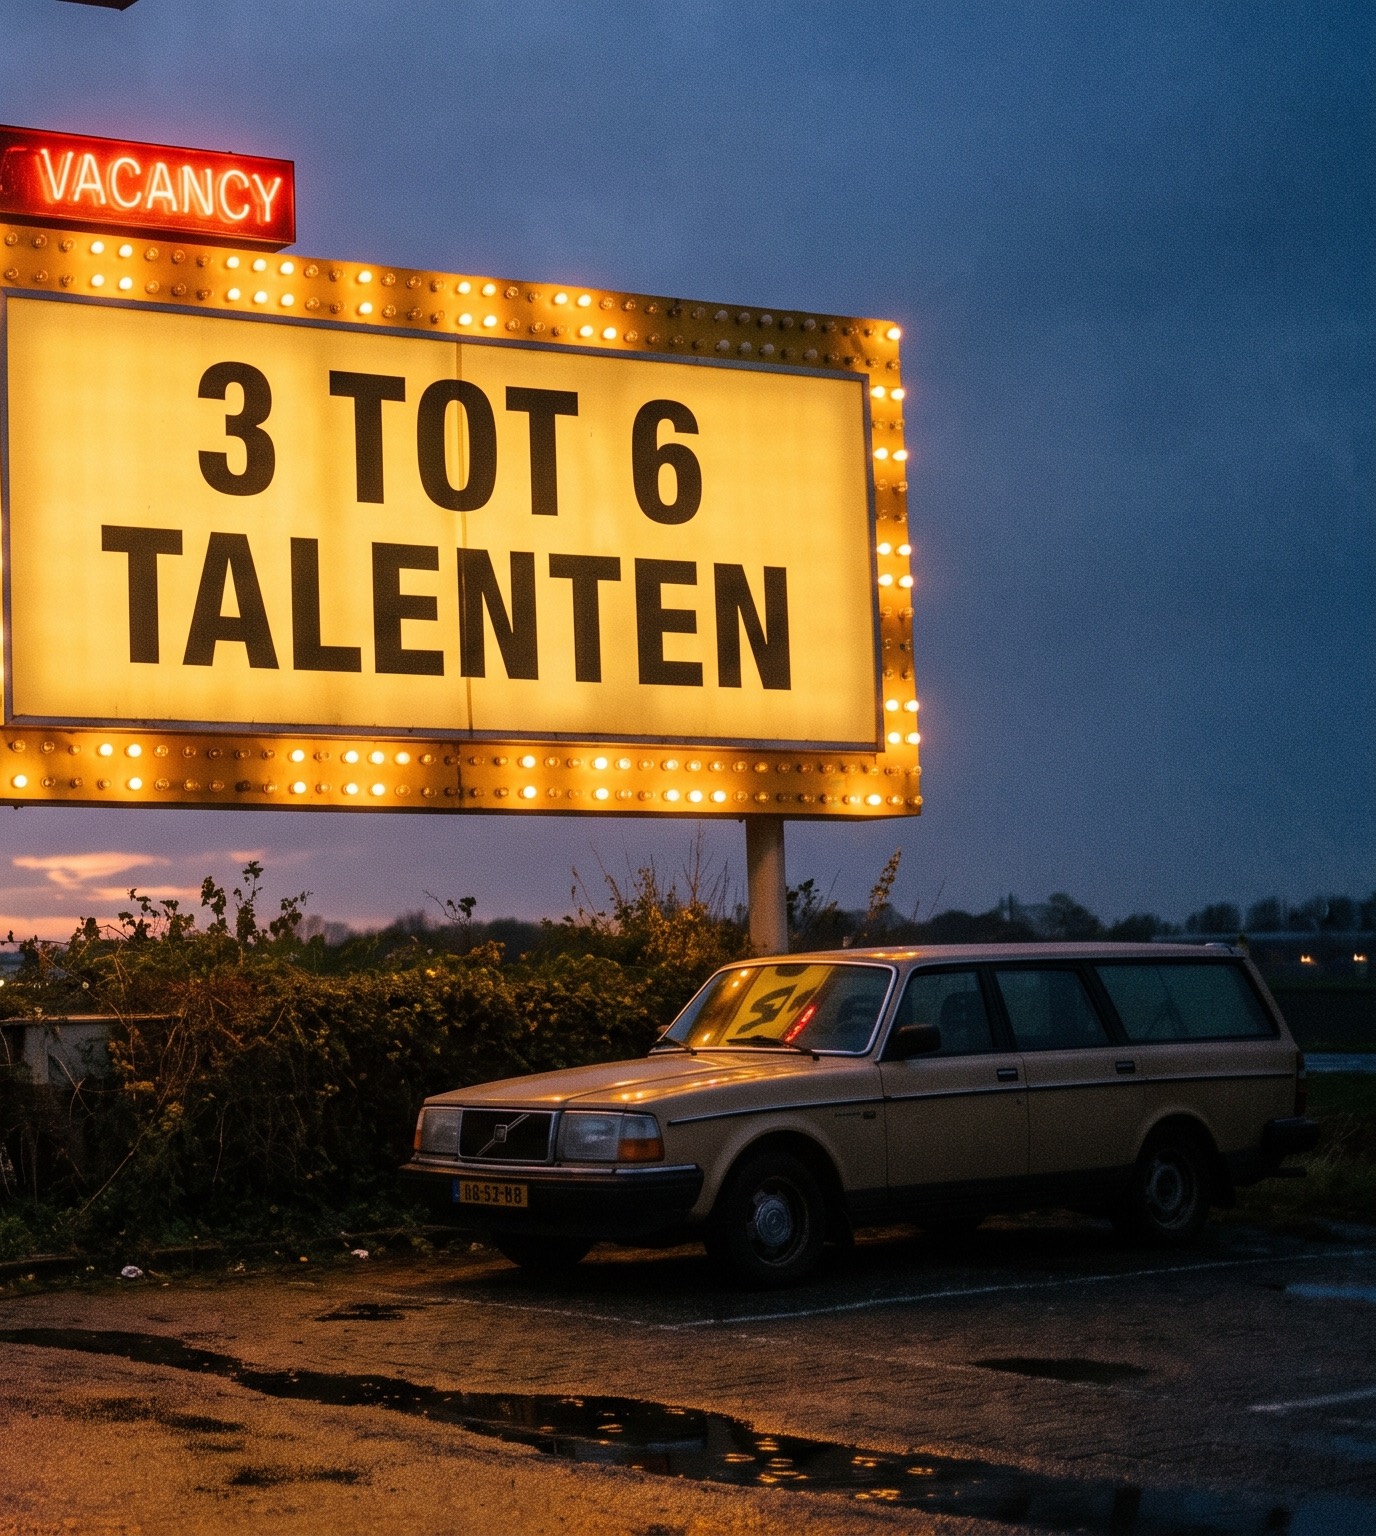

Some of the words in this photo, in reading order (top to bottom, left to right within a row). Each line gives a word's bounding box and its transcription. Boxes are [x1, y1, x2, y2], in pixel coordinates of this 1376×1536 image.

[39, 148, 282, 222] VACANCY
[198, 361, 276, 497] 3
[328, 370, 579, 517] TOT
[632, 399, 703, 526] 6
[101, 525, 792, 691] TALENTEN
